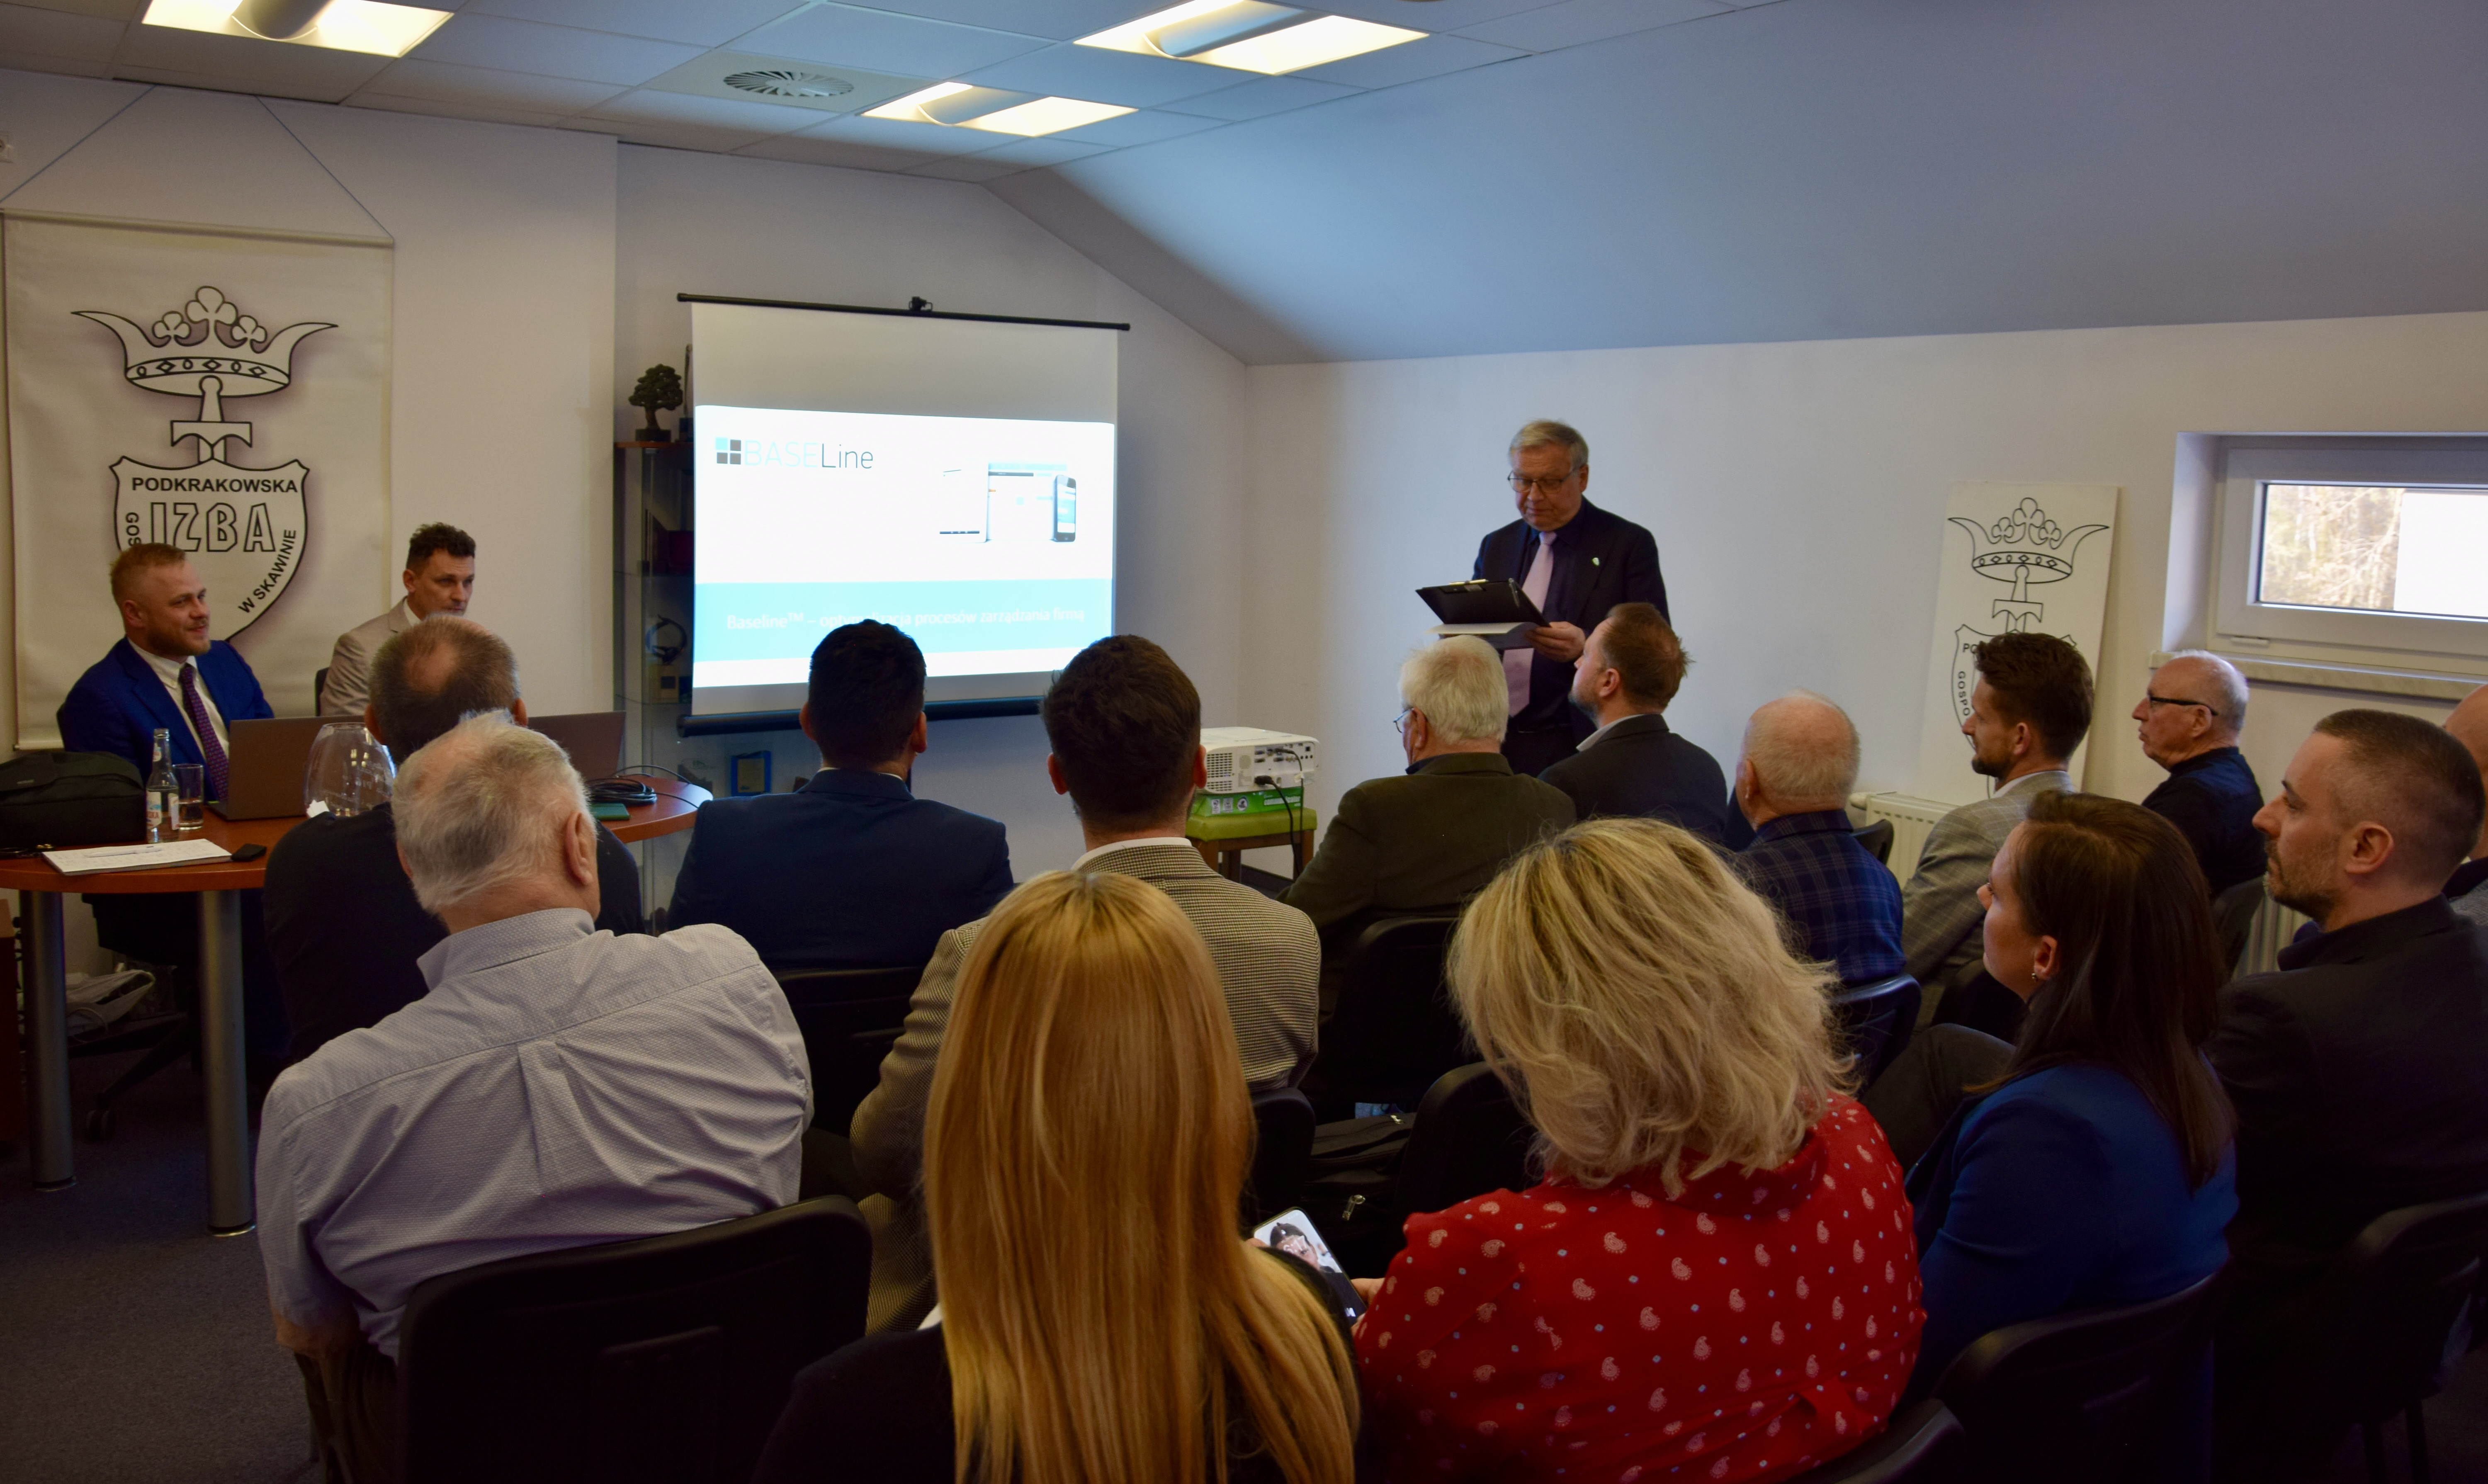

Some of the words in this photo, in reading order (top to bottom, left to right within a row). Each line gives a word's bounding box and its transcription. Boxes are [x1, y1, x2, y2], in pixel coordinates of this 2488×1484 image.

[745, 440, 873, 469] BASELine
[132, 477, 298, 493] PODKRAKOWSKA
[126, 512, 141, 546] GOS
[150, 502, 276, 553] IZBA
[238, 597, 255, 613] W
[253, 529, 296, 600] SKAWINIE
[915, 609, 976, 627] procesów
[980, 608, 1051, 624] zarządzania
[1052, 606, 1085, 623] firmą
[1958, 671, 1970, 716] GOSPO
